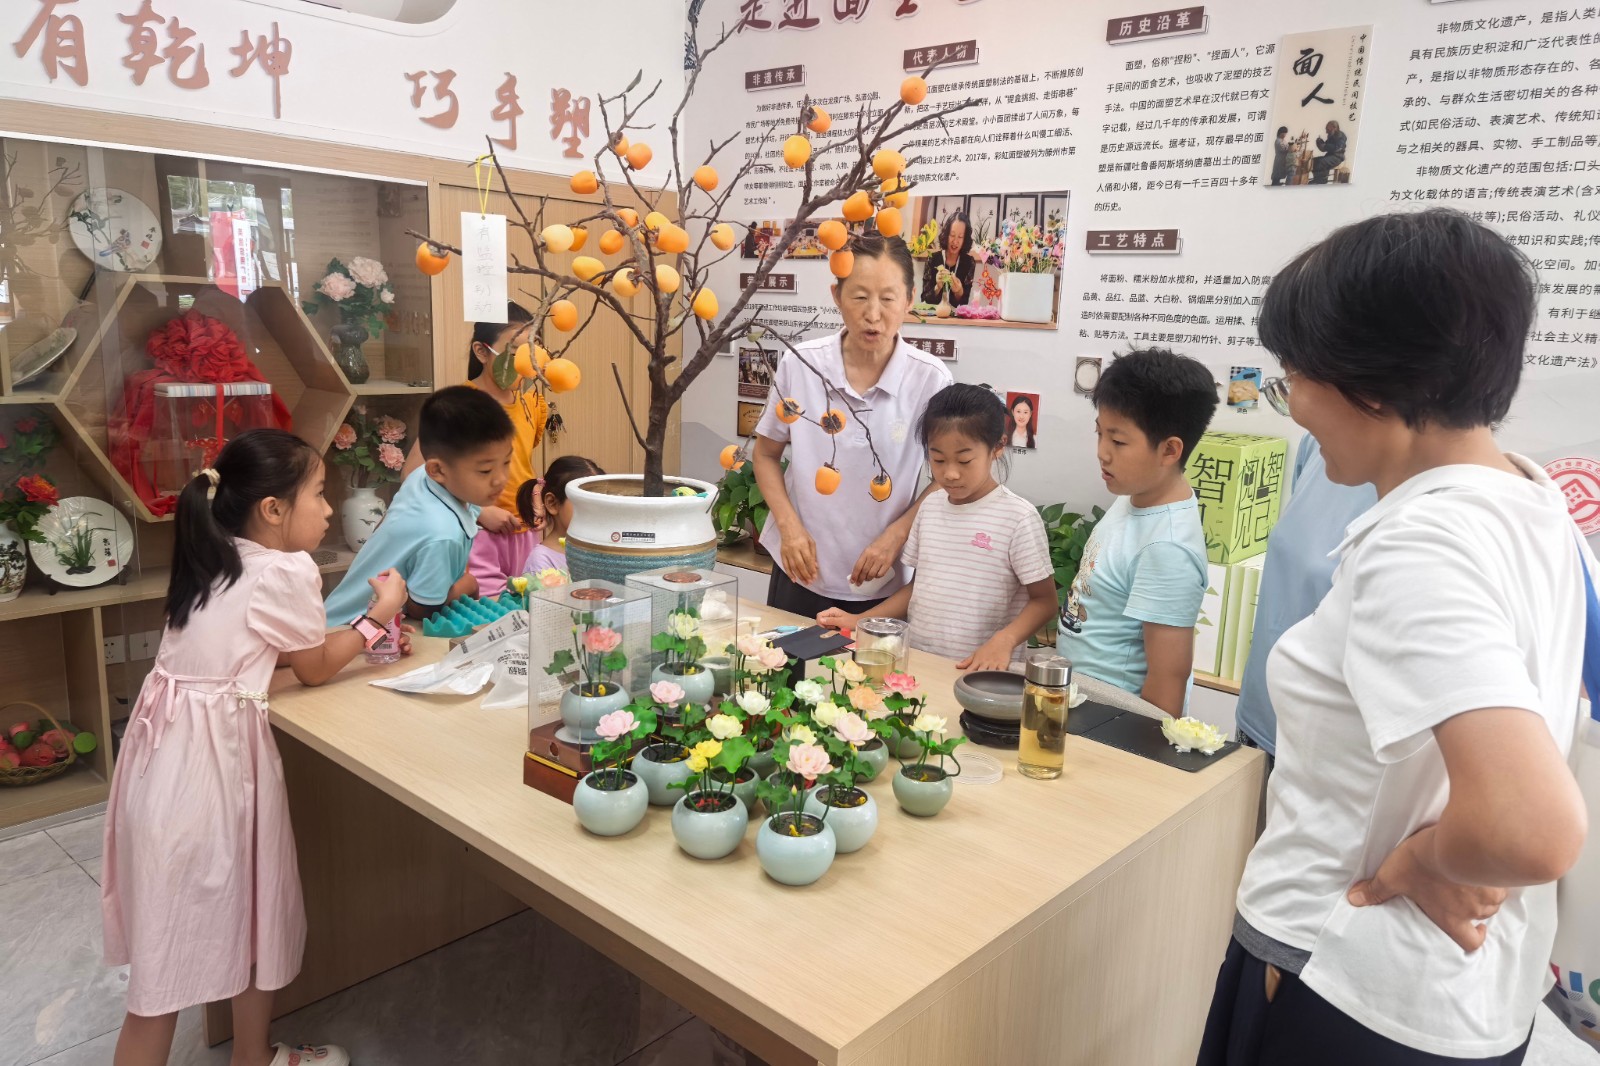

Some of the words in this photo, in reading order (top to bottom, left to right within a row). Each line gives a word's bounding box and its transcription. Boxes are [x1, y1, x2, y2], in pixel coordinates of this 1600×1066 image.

[1119, 11, 1192, 36] 历史沿革
[1437, 7, 1600, 34] 非物质文化遗产，是指人类
[913, 44, 967, 65] 代表人物
[13, 0, 293, 118] 有乾坤
[404, 69, 592, 159] 巧手塑
[753, 68, 795, 86] 非遗传承
[1293, 48, 1335, 108] 面人
[1349, 33, 1368, 122] 中国传统民间技艺
[1403, 83, 1600, 108] 承的、与群众生活密切相关的各种
[1102, 110, 1267, 133] 字记载，经过几千年的传承和发展，可谓
[1100, 132, 1264, 154] 是历史源远流长。据考证，现存最早的面
[1396, 134, 1600, 155] 与之相关的器具、实物、手工制品等
[1096, 175, 1258, 192] 人俑和小猪，距今已有一千三百四十多年
[1094, 202, 1122, 212] 的历史。
[1098, 232, 1165, 248] 工艺特点
[1100, 273, 1274, 286] 将面粉、糯米粉加水搅和，并适量加入防腐
[1525, 330, 1600, 345] 社会主义精
